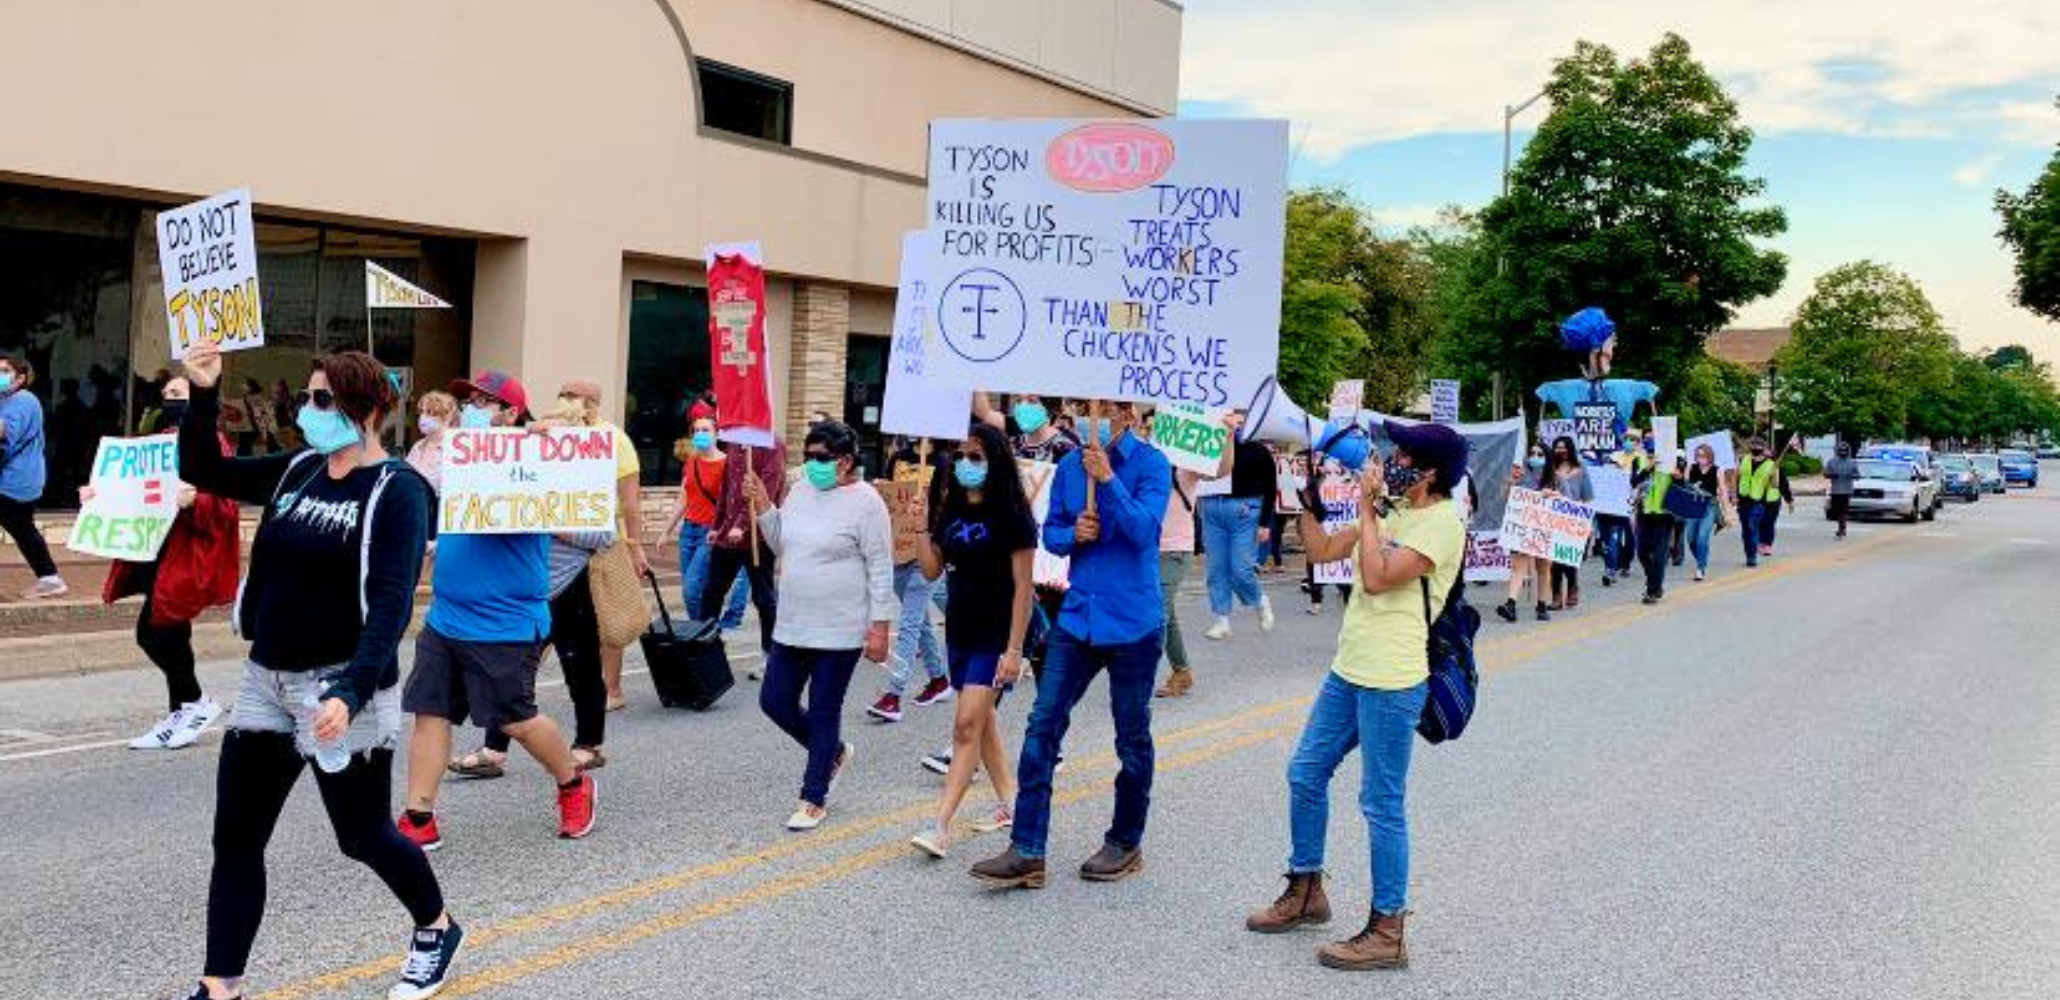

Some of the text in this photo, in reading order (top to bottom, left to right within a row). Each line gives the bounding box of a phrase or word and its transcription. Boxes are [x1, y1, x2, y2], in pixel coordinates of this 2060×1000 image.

[945, 145, 1030, 172] TYSON
[969, 174, 996, 200] IS
[1150, 184, 1241, 220] TYSON
[166, 200, 240, 250] DO NOT
[935, 201, 1056, 232] KILLING US
[943, 230, 1094, 267] FOR PROFITS
[1128, 219, 1213, 249] TREATS
[179, 242, 237, 283] BELIEVE
[1122, 246, 1242, 277] WORKERS
[1121, 275, 1222, 305] WORST
[169, 277, 259, 350] TYSON
[1042, 297, 1167, 333] THAN THE
[1063, 328, 1229, 368] CHICKENS WE
[1119, 365, 1229, 407] PROCESS
[1576, 418, 1614, 435] ARE
[451, 430, 614, 465] SHUT DOWN
[510, 465, 539, 482] the
[443, 489, 611, 532] FACTORIES
[1552, 498, 1594, 519] DOWN
[1553, 542, 1583, 563] WAY
